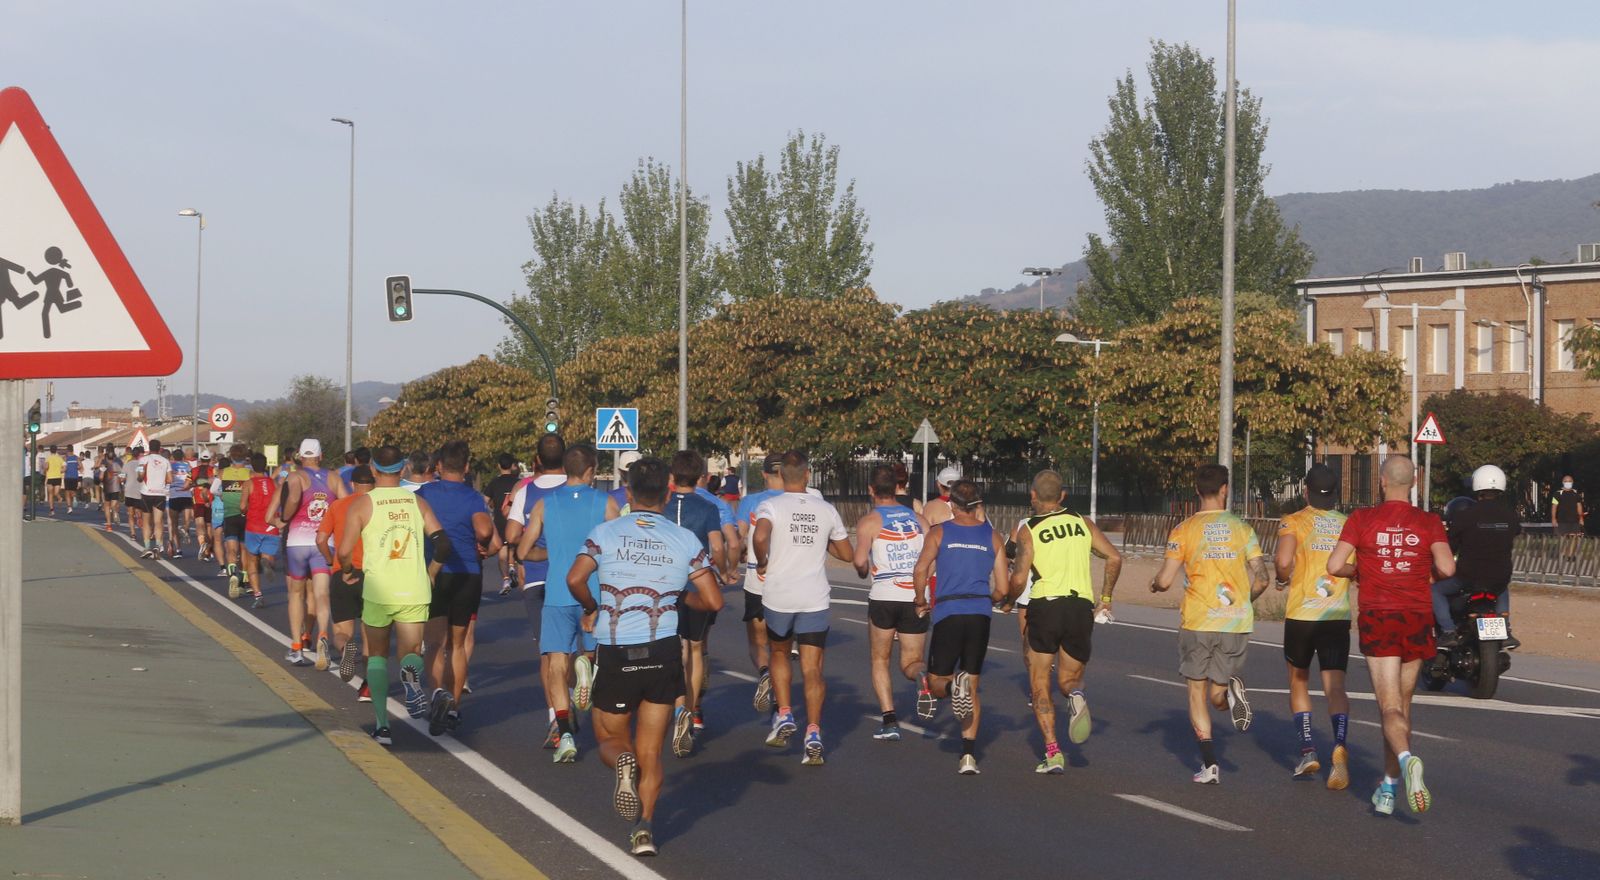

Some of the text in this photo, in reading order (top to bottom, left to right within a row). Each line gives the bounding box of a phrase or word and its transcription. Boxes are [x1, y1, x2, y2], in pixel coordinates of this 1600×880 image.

[215, 413, 229, 422] 20
[792, 512, 816, 522] CORRER
[789, 523, 819, 534] SIN TENER
[1039, 523, 1086, 543] GUIA
[618, 535, 667, 551] Triatlon
[793, 535, 814, 544] NI IDEA
[886, 542, 909, 553] Club
[889, 560, 916, 571] Luce
[1485, 627, 1500, 635] LGC
